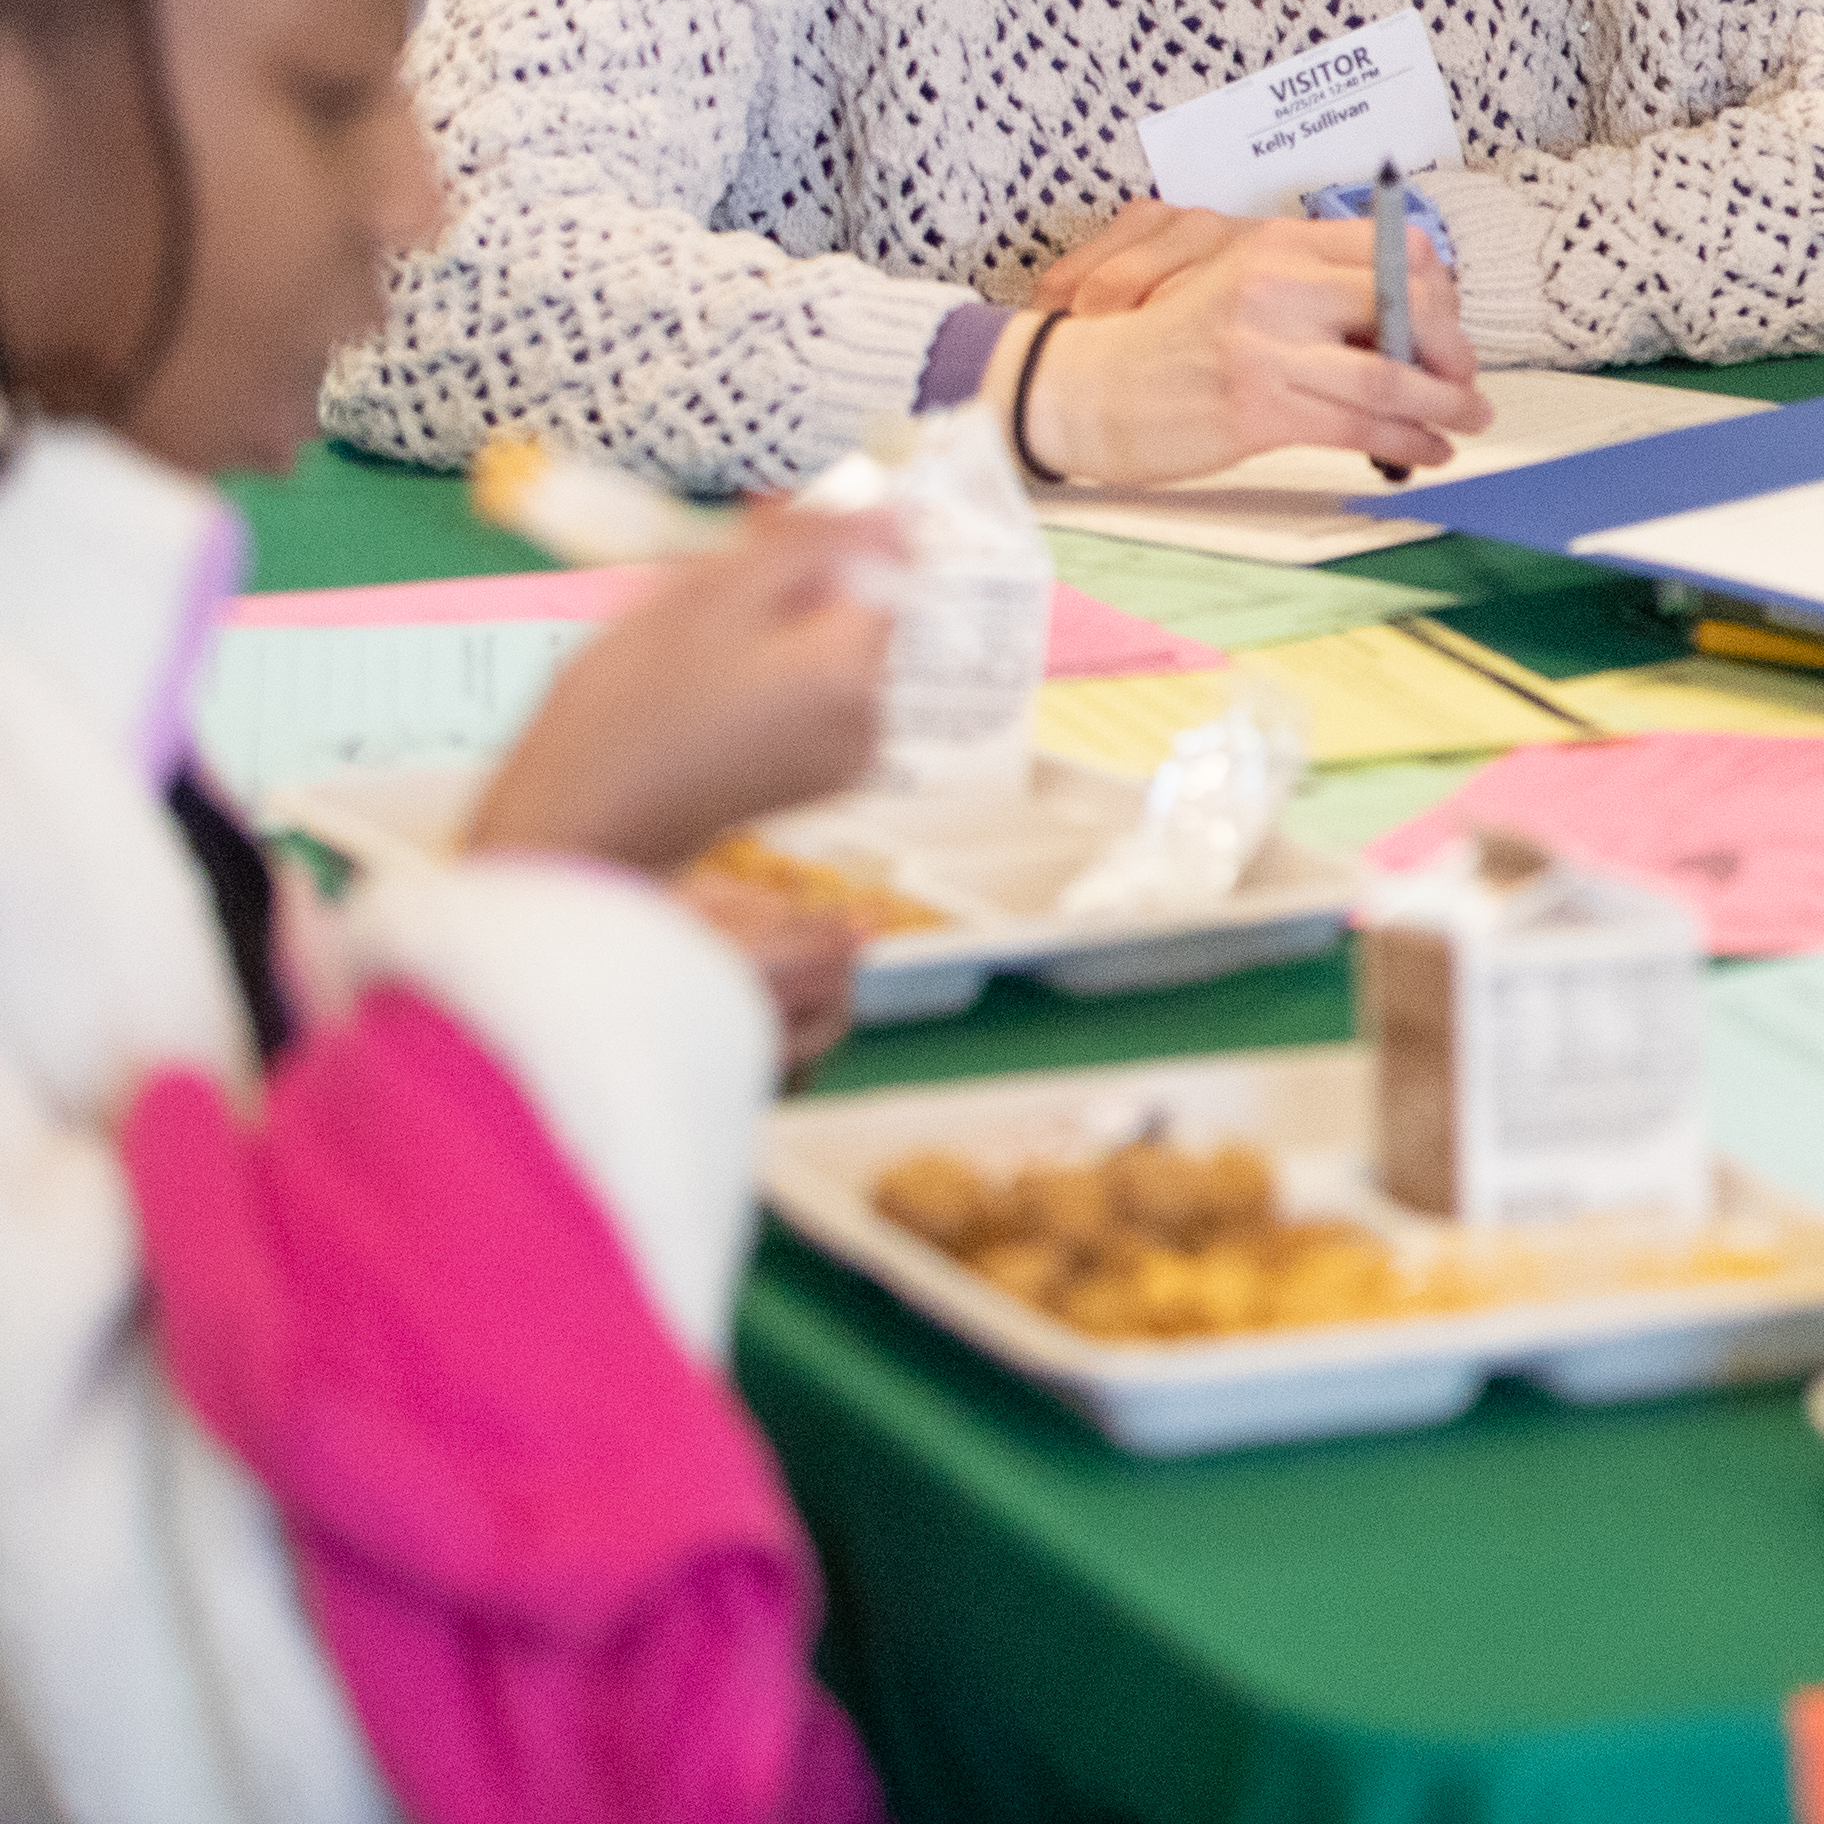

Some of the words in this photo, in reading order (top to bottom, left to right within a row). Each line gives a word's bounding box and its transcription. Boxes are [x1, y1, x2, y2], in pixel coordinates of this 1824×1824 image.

[1269, 46, 1374, 103] VISITOR
[1361, 66, 1380, 85] PM
[1251, 129, 1297, 158] Kelly
[1300, 100, 1370, 139] Sullivan
